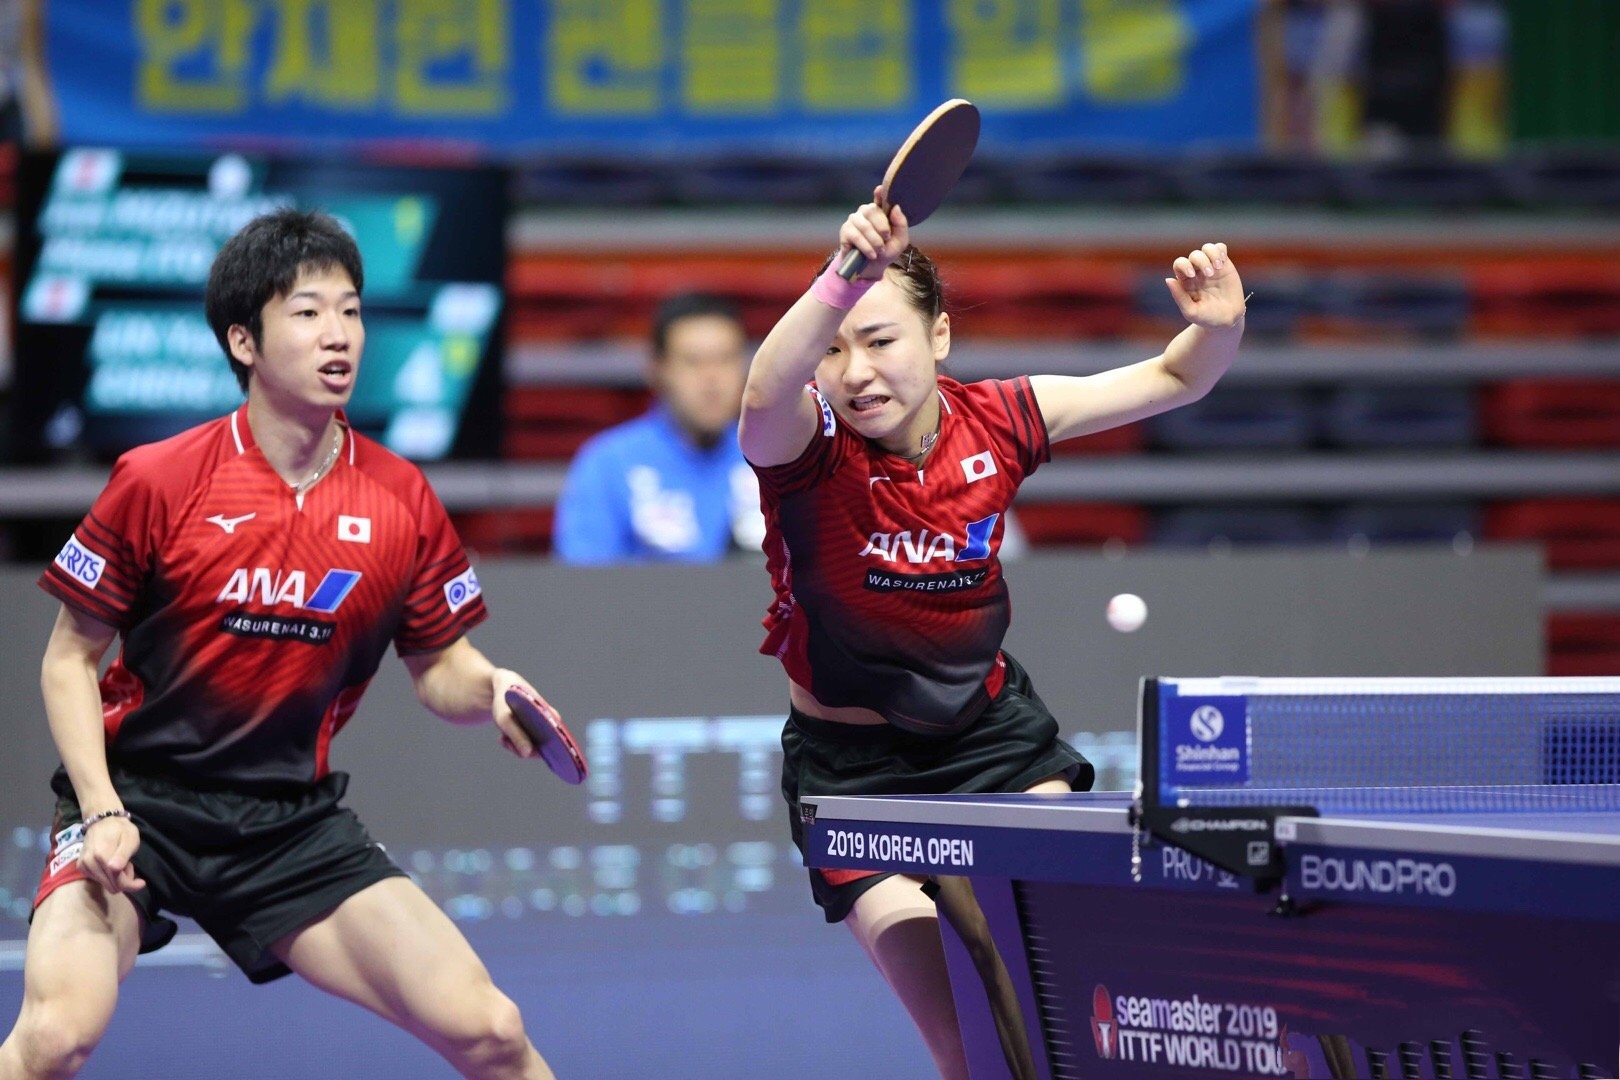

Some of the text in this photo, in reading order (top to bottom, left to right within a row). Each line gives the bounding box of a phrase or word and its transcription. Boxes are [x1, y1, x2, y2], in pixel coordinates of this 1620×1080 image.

[859, 529, 954, 563] ANA
[216, 567, 306, 608] ANA
[223, 616, 305, 635] WASURENAI
[827, 830, 974, 866] 2019 KOREA OPEN
[1301, 854, 1457, 897] BOUNDPRO
[1116, 994, 1278, 1039] seamaster 2019
[1118, 1029, 1162, 1062] ITTF
[1164, 1033, 1241, 1070] WORLD
